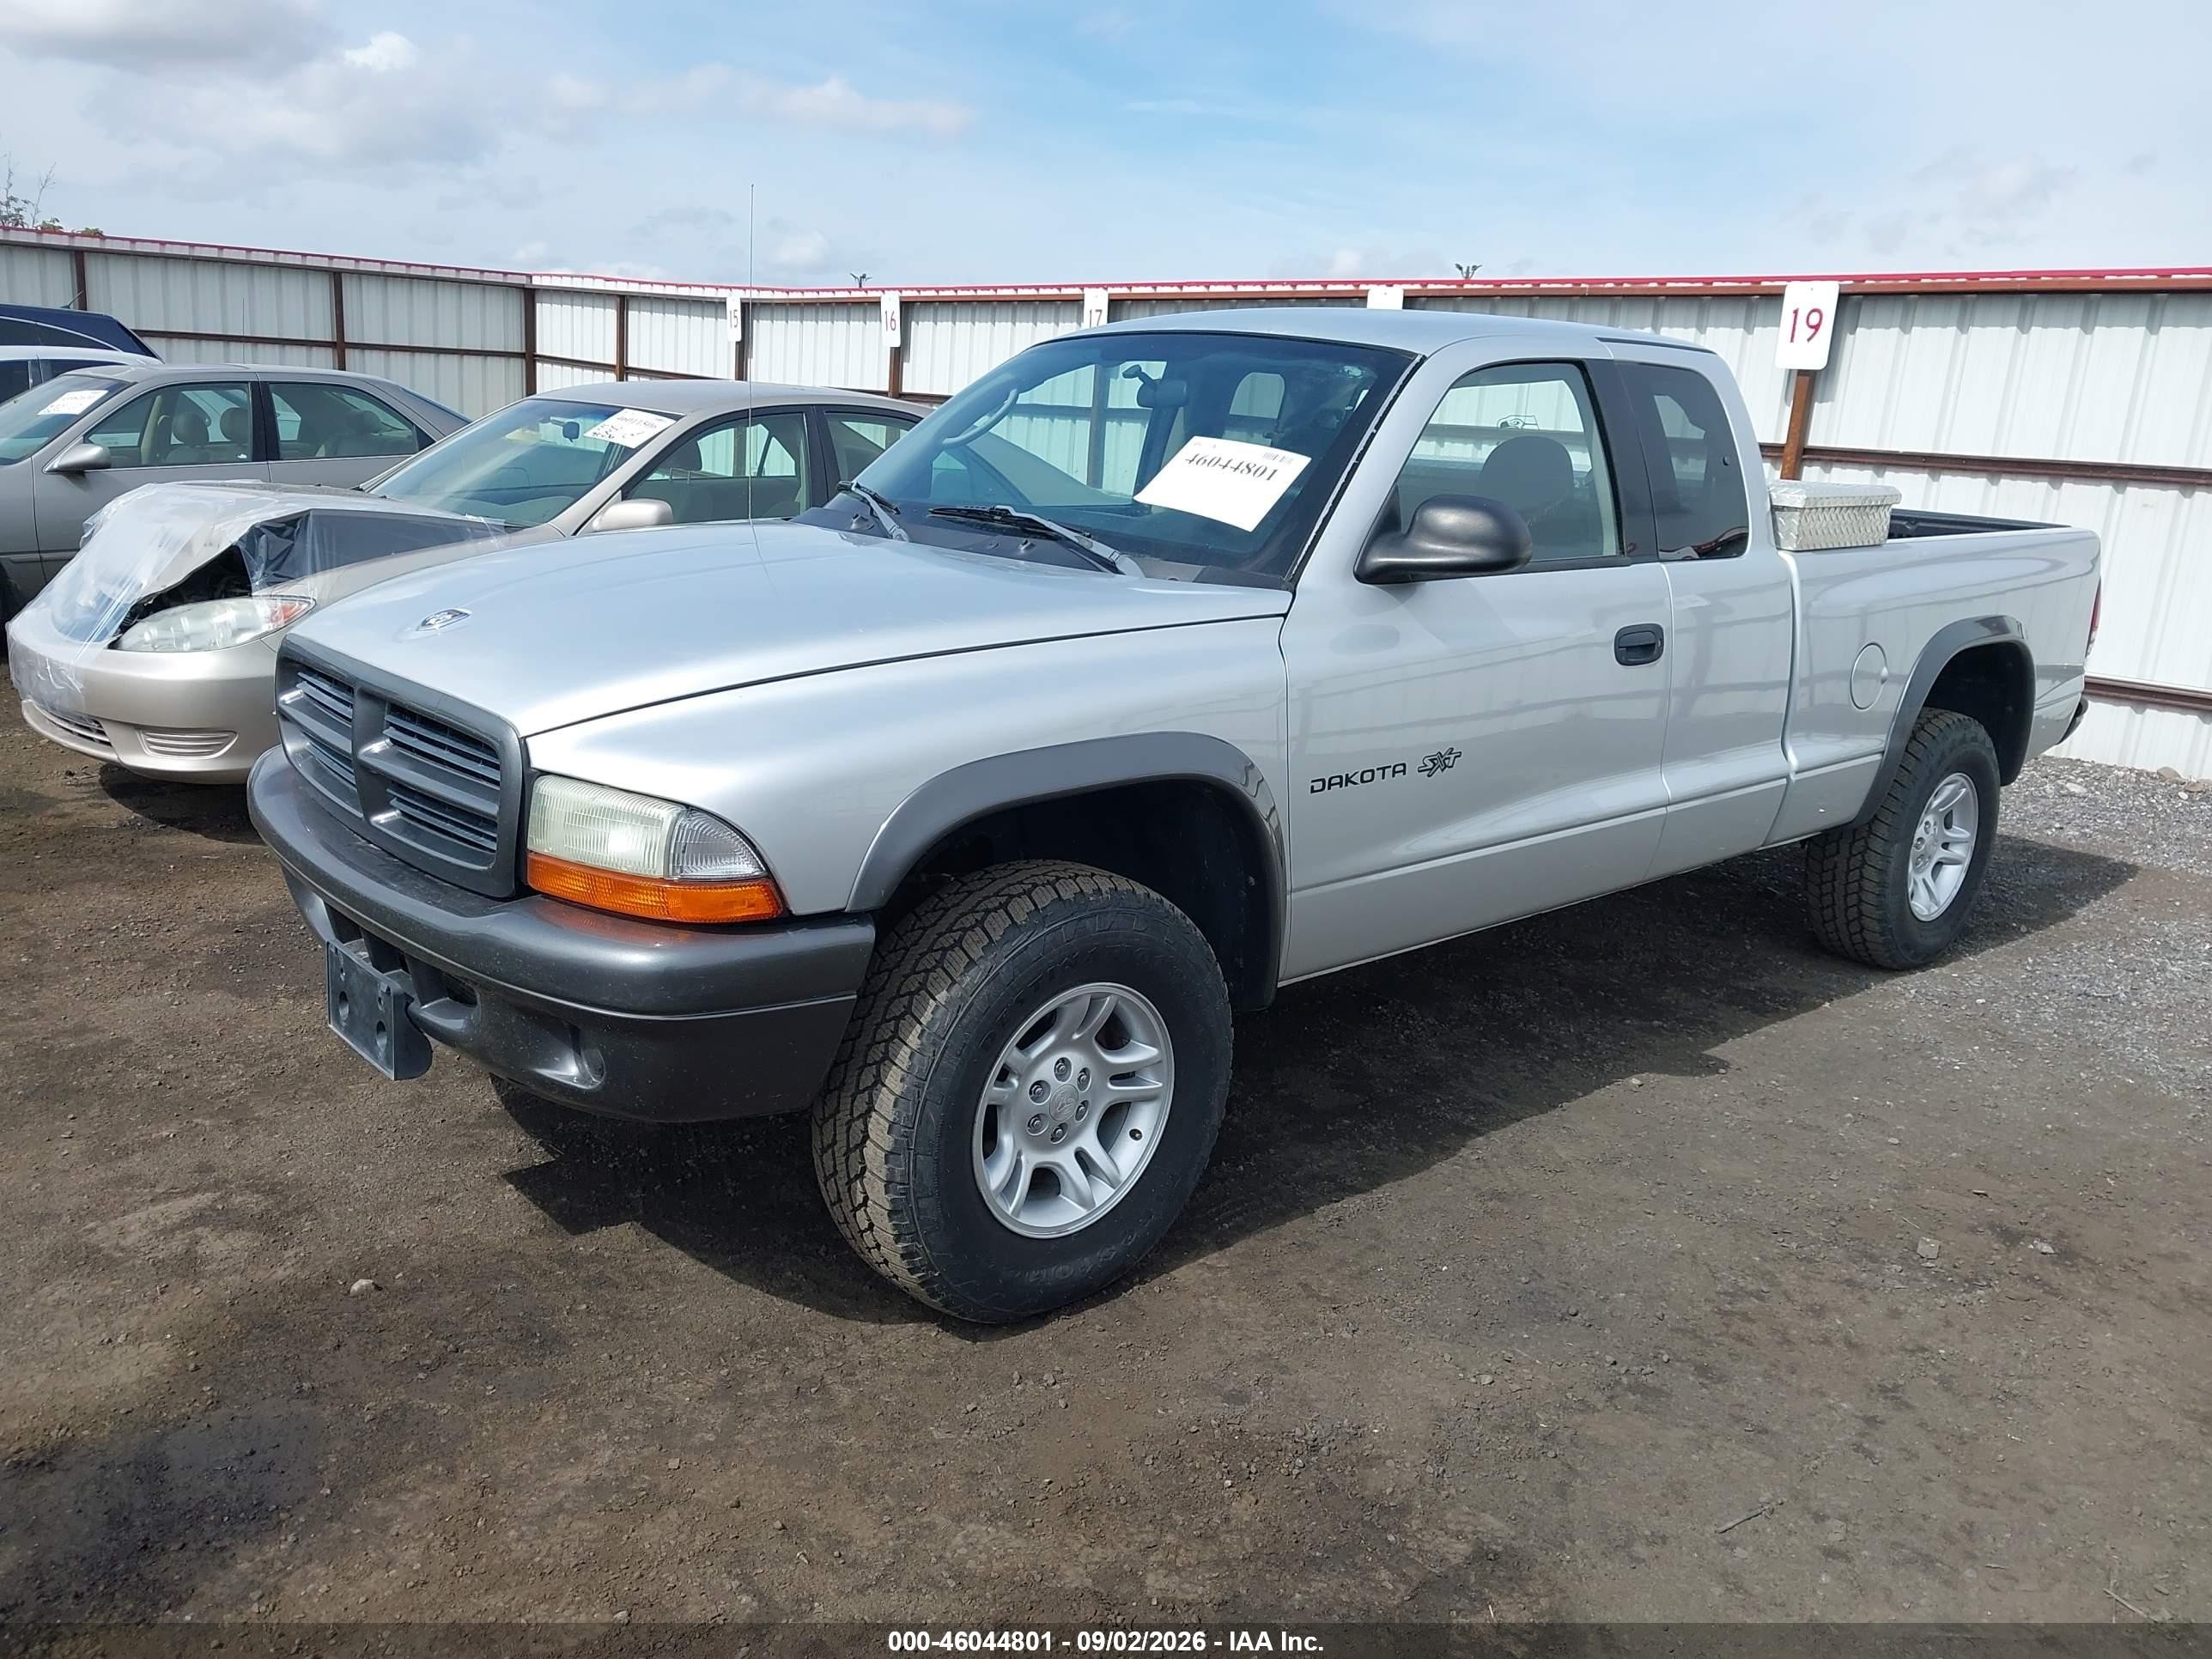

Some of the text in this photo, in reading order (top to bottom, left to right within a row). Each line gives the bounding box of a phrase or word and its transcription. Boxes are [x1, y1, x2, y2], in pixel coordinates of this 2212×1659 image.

[729, 309, 738, 329] 15
[884, 310, 896, 331] 16
[1089, 309, 1103, 328] 17
[1790, 307, 1824, 343] 19
[1185, 453, 1279, 481] 46044801
[1310, 747, 1462, 794] DAKOTA SXT
